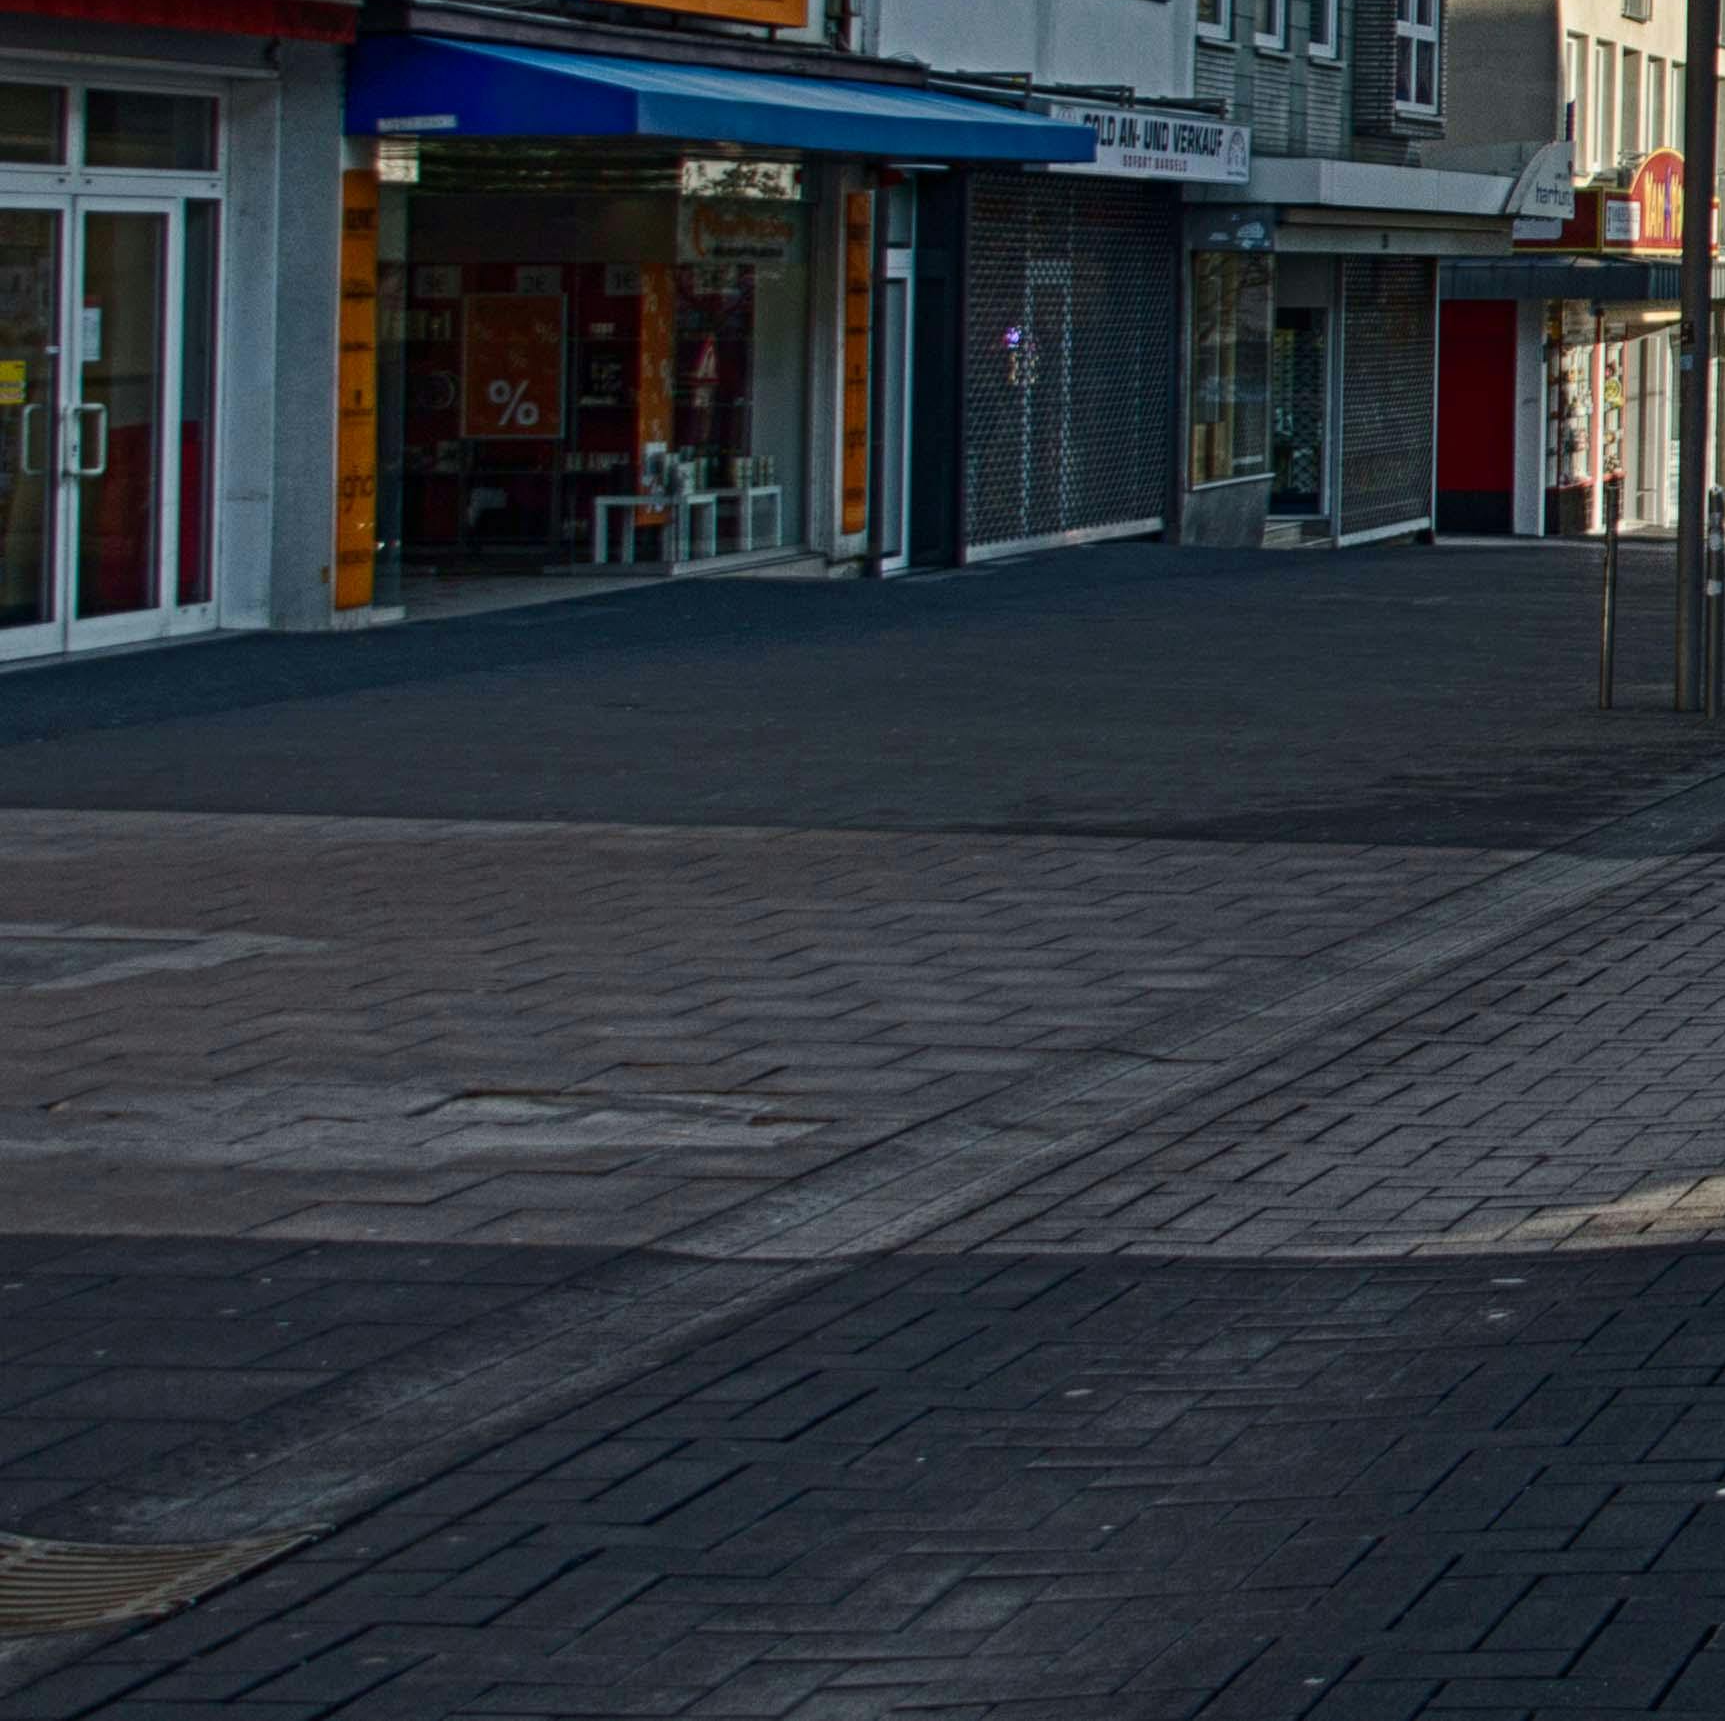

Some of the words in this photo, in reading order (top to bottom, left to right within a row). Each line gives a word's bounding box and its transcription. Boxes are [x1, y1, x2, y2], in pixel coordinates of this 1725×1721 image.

[1119, 117, 1140, 148] AN-
[1144, 119, 1169, 152] UND
[1173, 123, 1223, 157] VERKAUF
